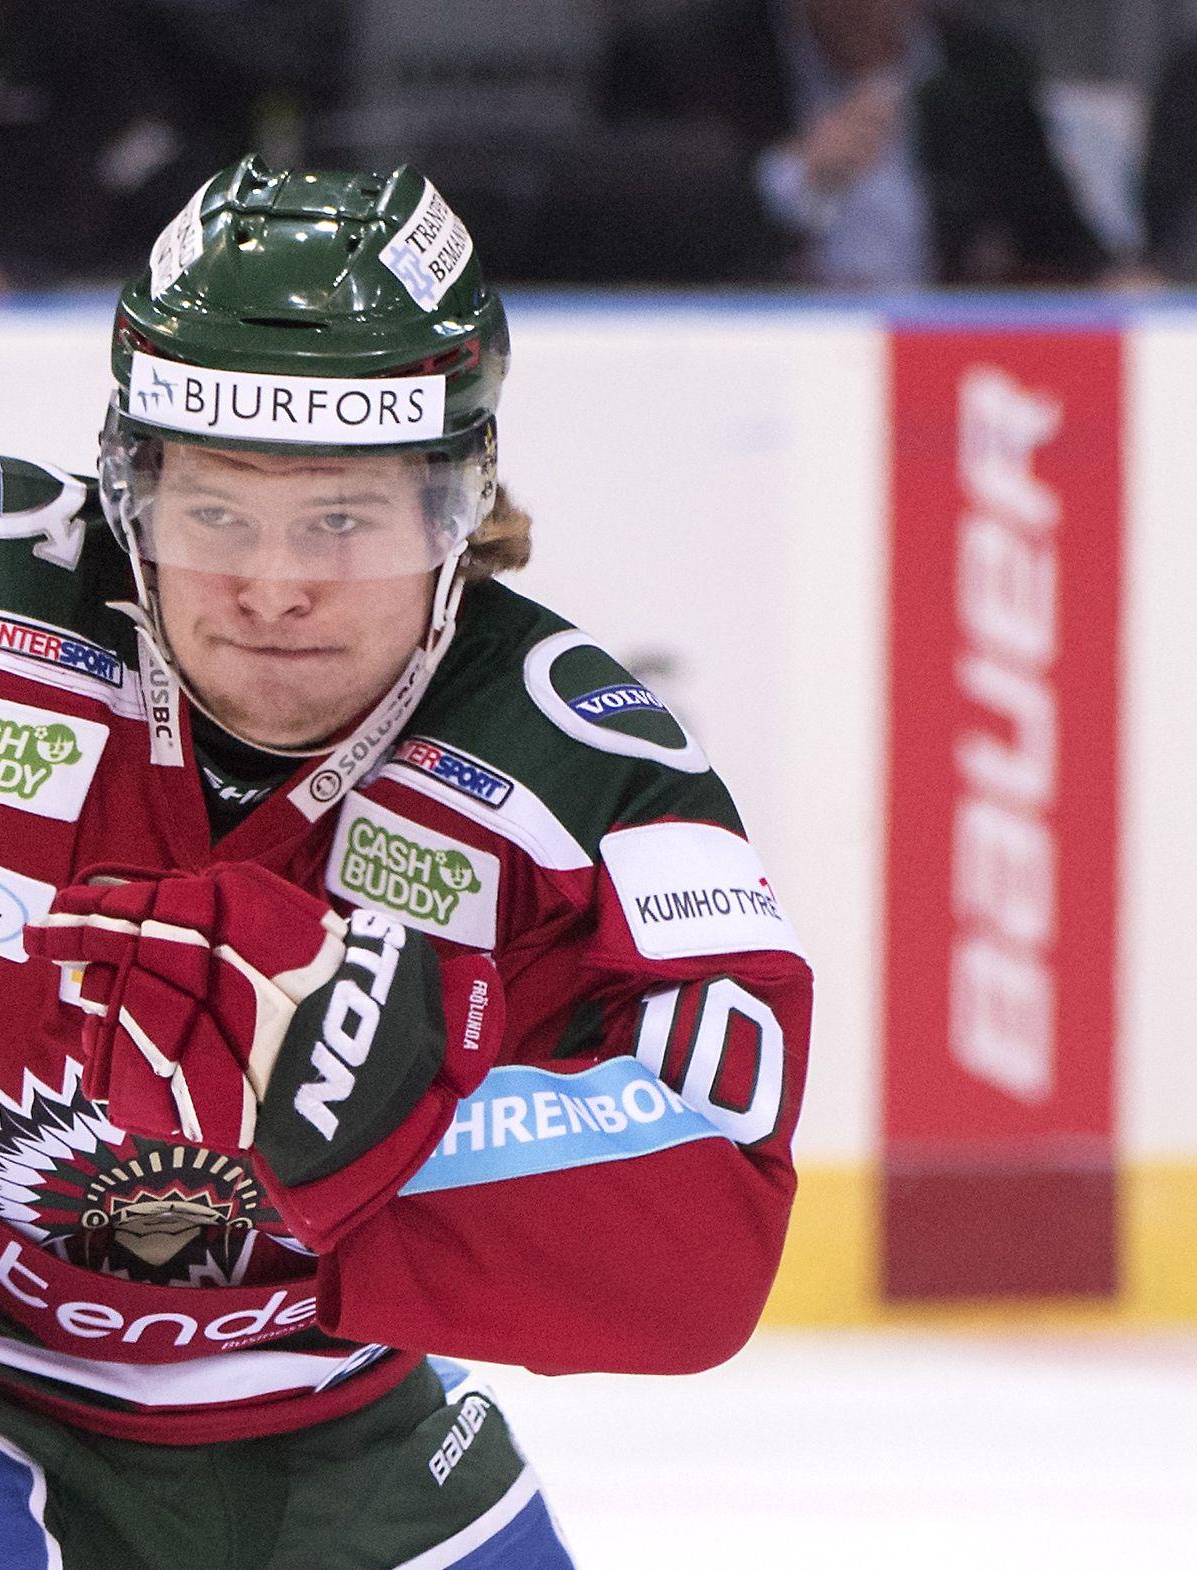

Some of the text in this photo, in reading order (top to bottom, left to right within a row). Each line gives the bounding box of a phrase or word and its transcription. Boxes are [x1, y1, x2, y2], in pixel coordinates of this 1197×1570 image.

[185, 377, 425, 427] BJURFORS
[349, 821, 435, 884] CASH
[344, 854, 459, 925] BUDDY
[635, 889, 731, 924] KUMHO
[463, 979, 489, 1051] FRÖLUNDA
